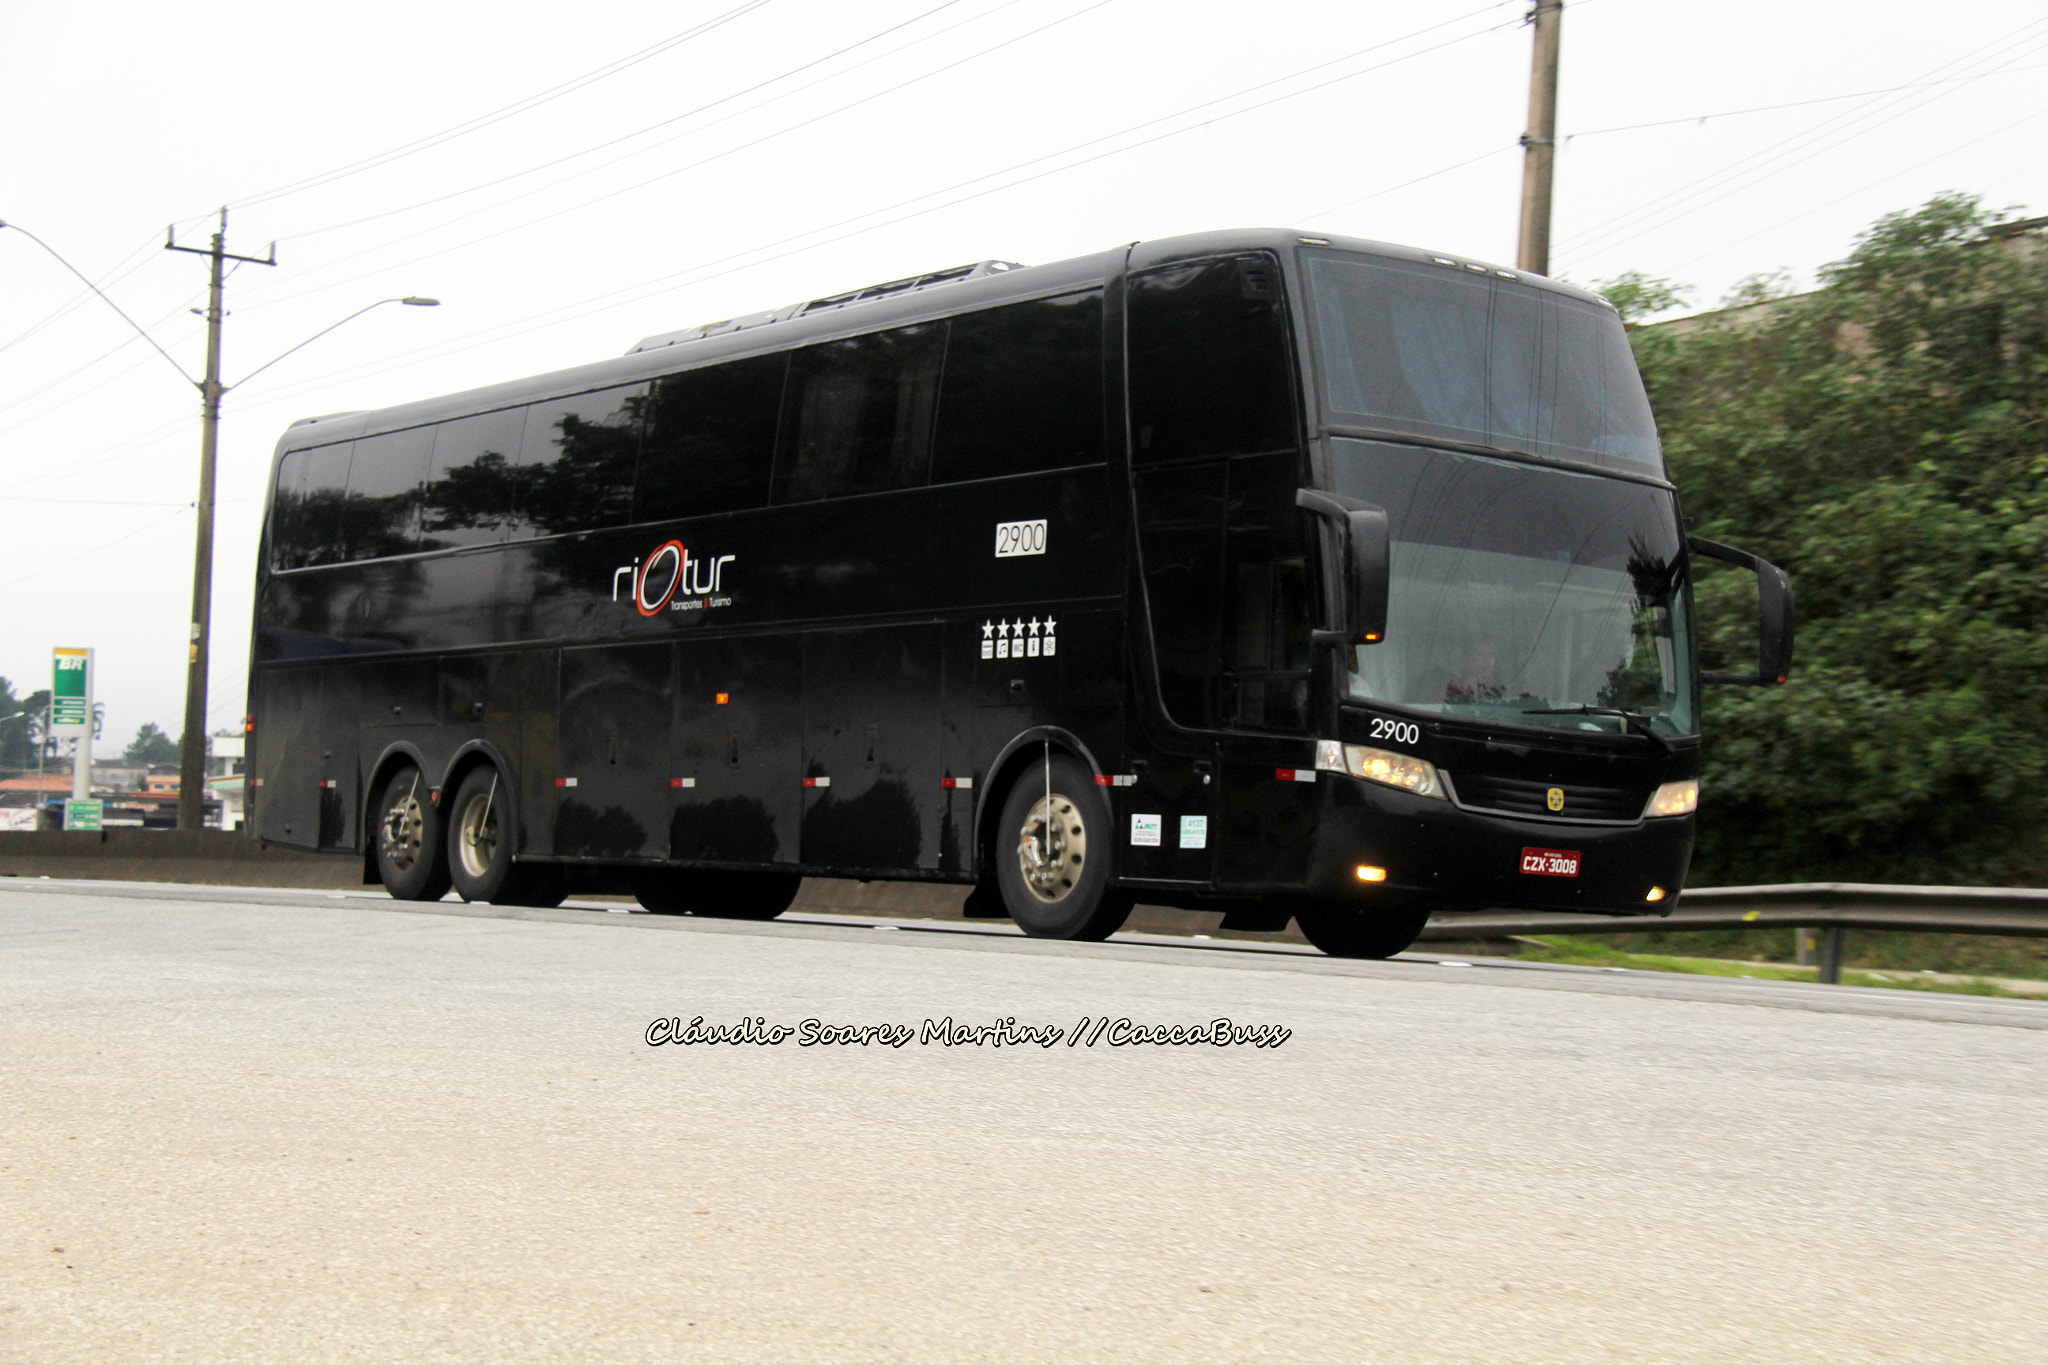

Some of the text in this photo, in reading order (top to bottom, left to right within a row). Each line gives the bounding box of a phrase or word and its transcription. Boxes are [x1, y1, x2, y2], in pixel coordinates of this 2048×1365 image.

[998, 523, 1046, 554] 2900
[671, 600, 703, 611] Transportes
[709, 597, 732, 608] Turismo
[58, 658, 84, 670] BR
[1369, 718, 1419, 745] 2900
